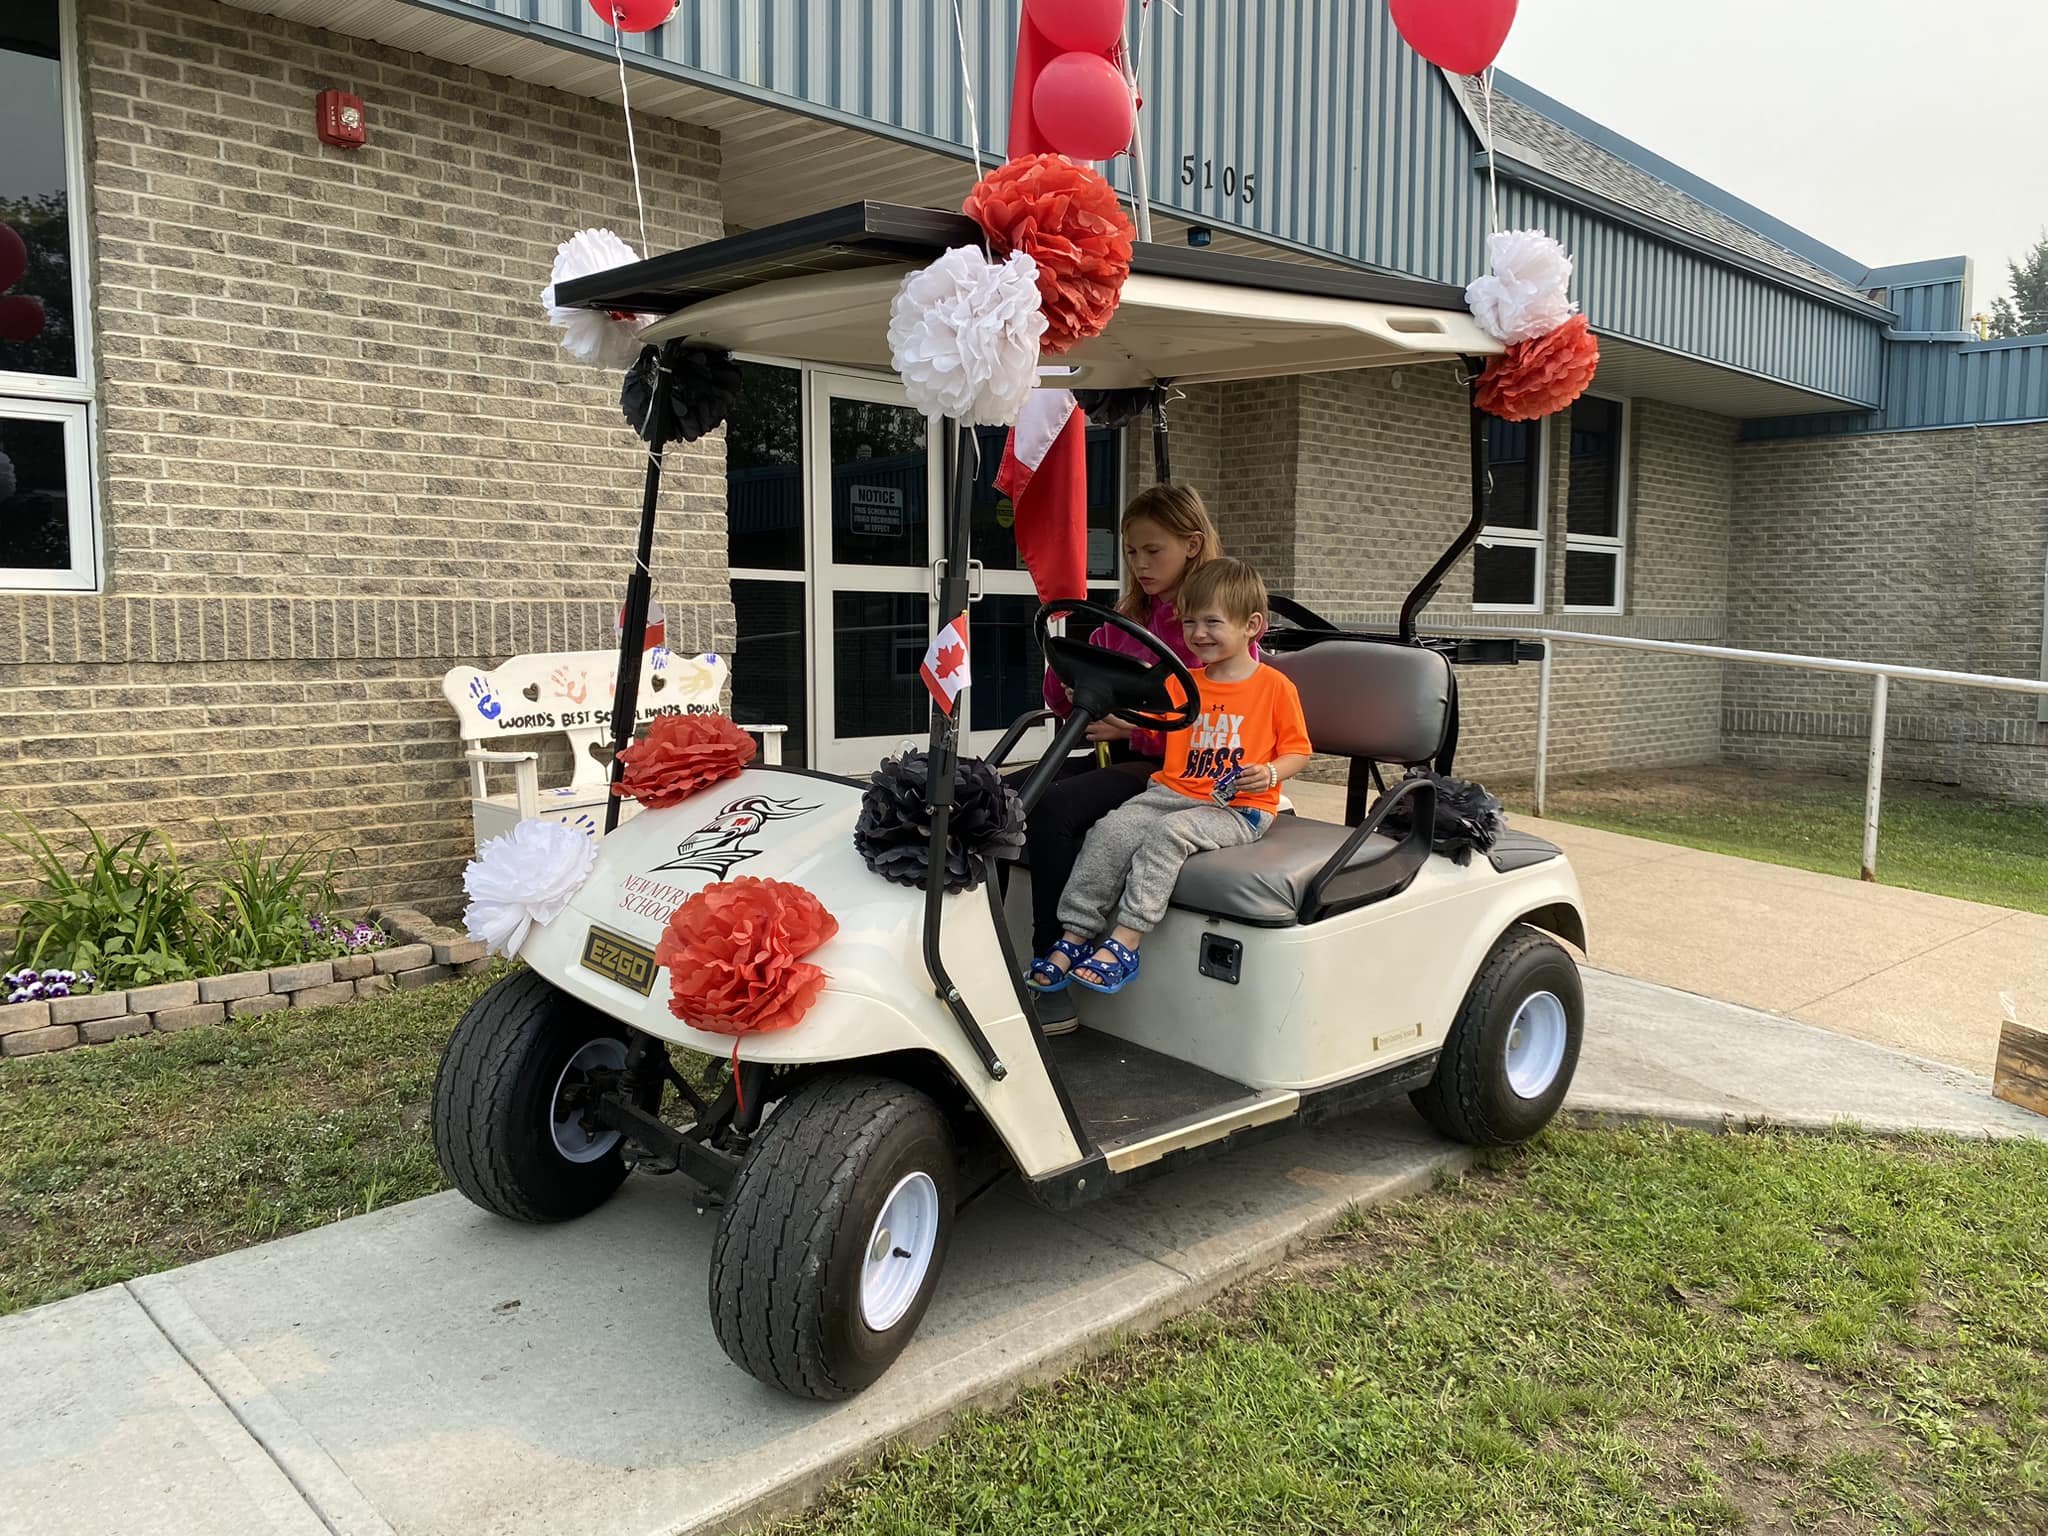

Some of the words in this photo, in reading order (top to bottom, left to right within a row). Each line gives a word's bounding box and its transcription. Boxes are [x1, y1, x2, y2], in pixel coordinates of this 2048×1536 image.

[1181, 154, 1255, 204] 5105
[858, 489, 895, 504] NOTICE
[561, 710, 591, 728] BEST
[594, 709, 643, 724] SCL
[1192, 713, 1244, 733] PLAY
[1191, 731, 1227, 750] LIKE
[1227, 733, 1242, 750] A
[619, 893, 676, 925] SCHOOL
[590, 938, 647, 982] EZGO
